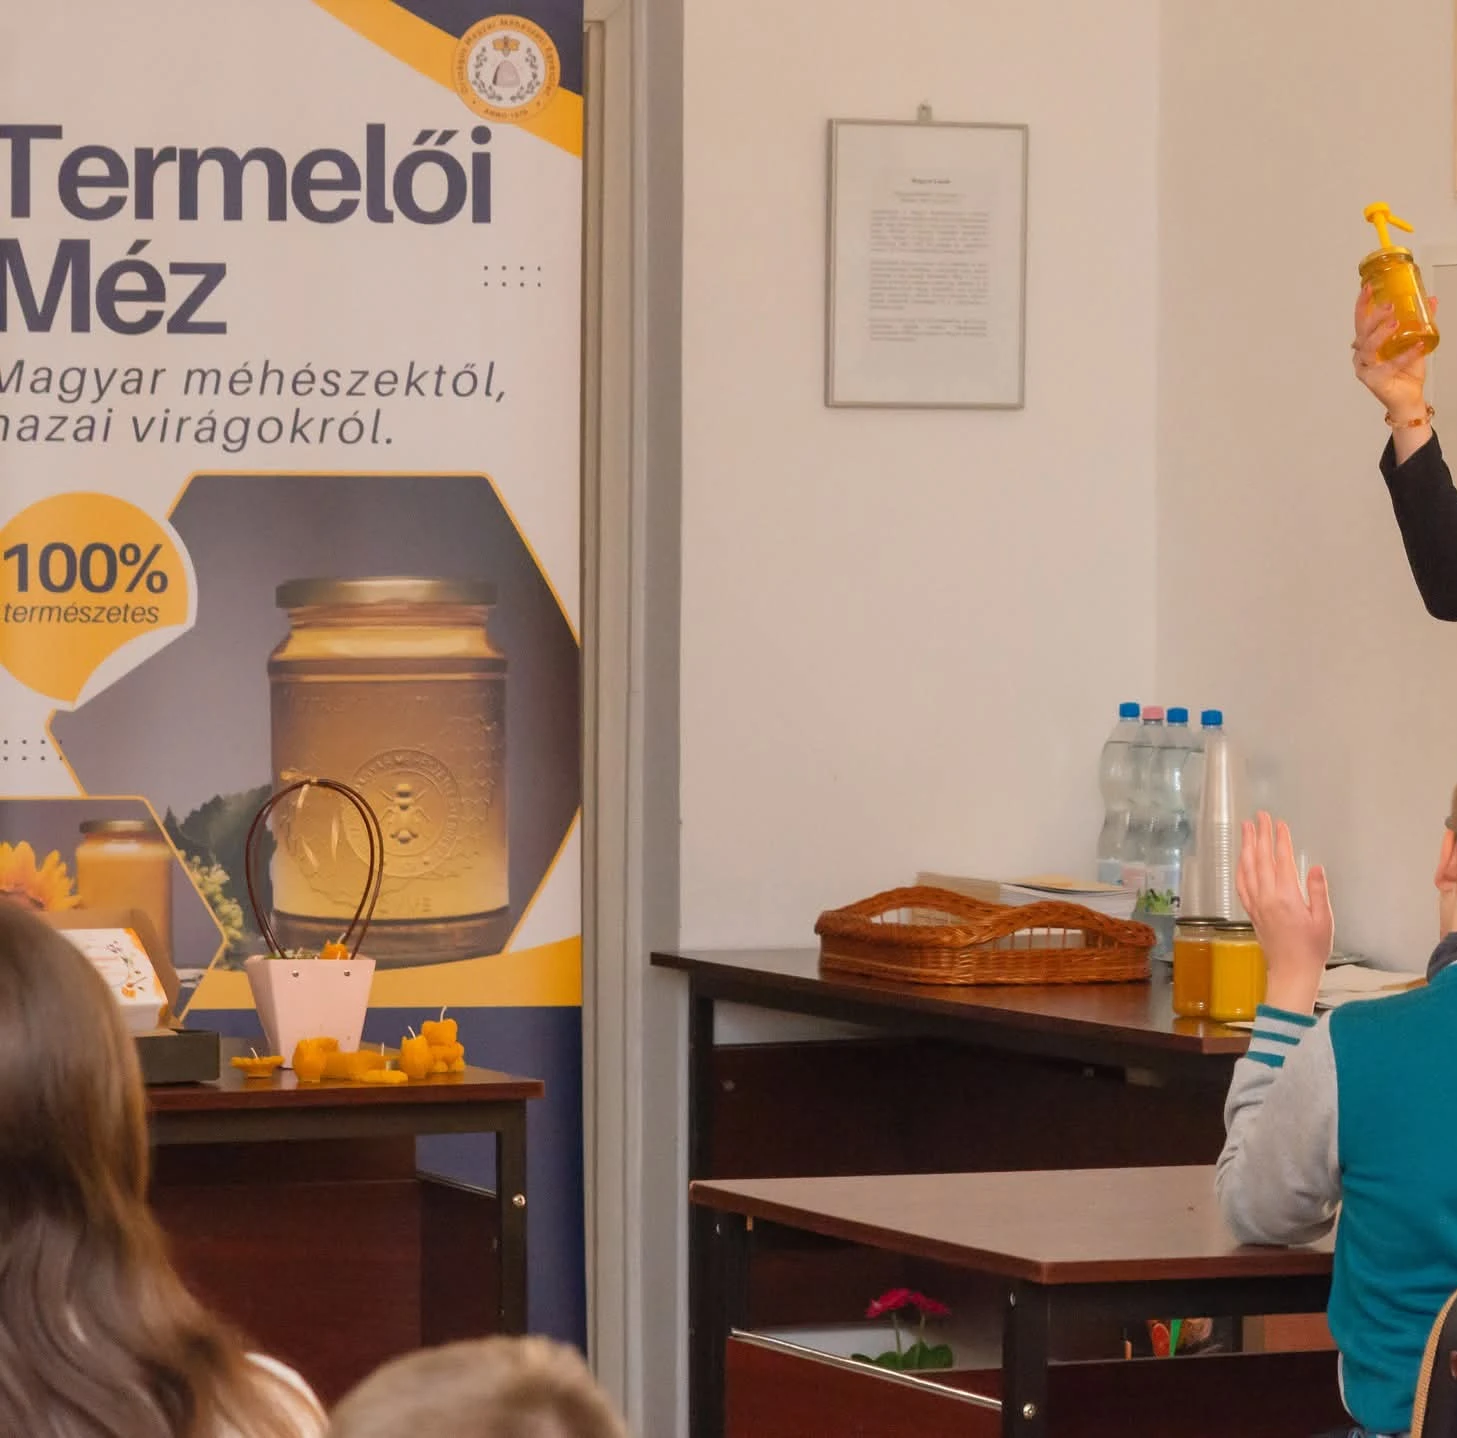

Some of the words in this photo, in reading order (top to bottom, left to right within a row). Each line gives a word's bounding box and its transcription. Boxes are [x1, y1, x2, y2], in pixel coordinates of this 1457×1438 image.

[0, 123, 492, 225] Termelői
[0, 238, 227, 335] Méz
[0, 359, 167, 404] Magyar
[183, 358, 505, 403] méhészektől,
[132, 406, 392, 453] virágokról.
[3, 542, 168, 594] 100%
[4, 602, 160, 624] természetes
